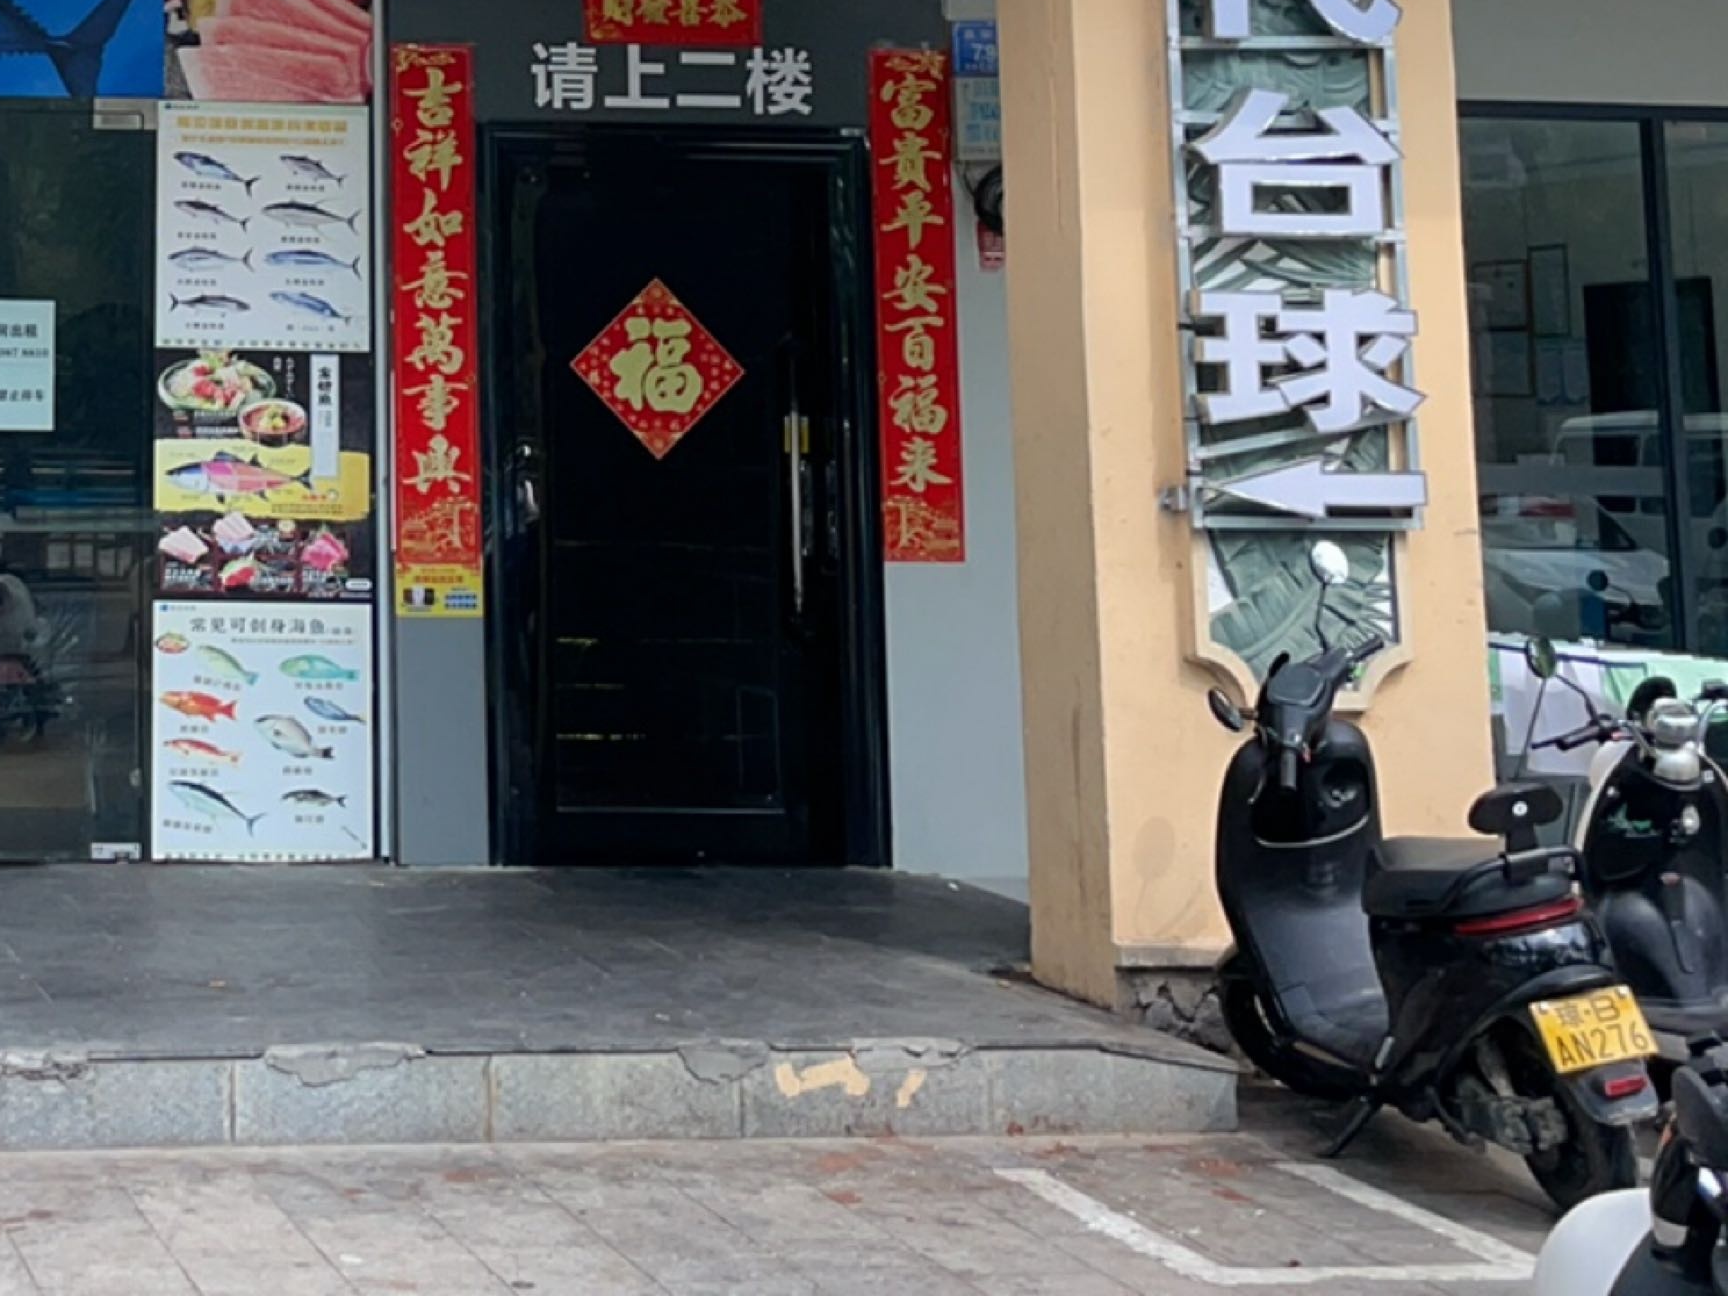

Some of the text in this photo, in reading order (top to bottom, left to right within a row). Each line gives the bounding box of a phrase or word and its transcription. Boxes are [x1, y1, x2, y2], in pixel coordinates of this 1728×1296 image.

[530, 42, 813, 115] 请上二楼
[609, 316, 704, 414] 福
[1555, 1023, 1649, 1066] AN276
